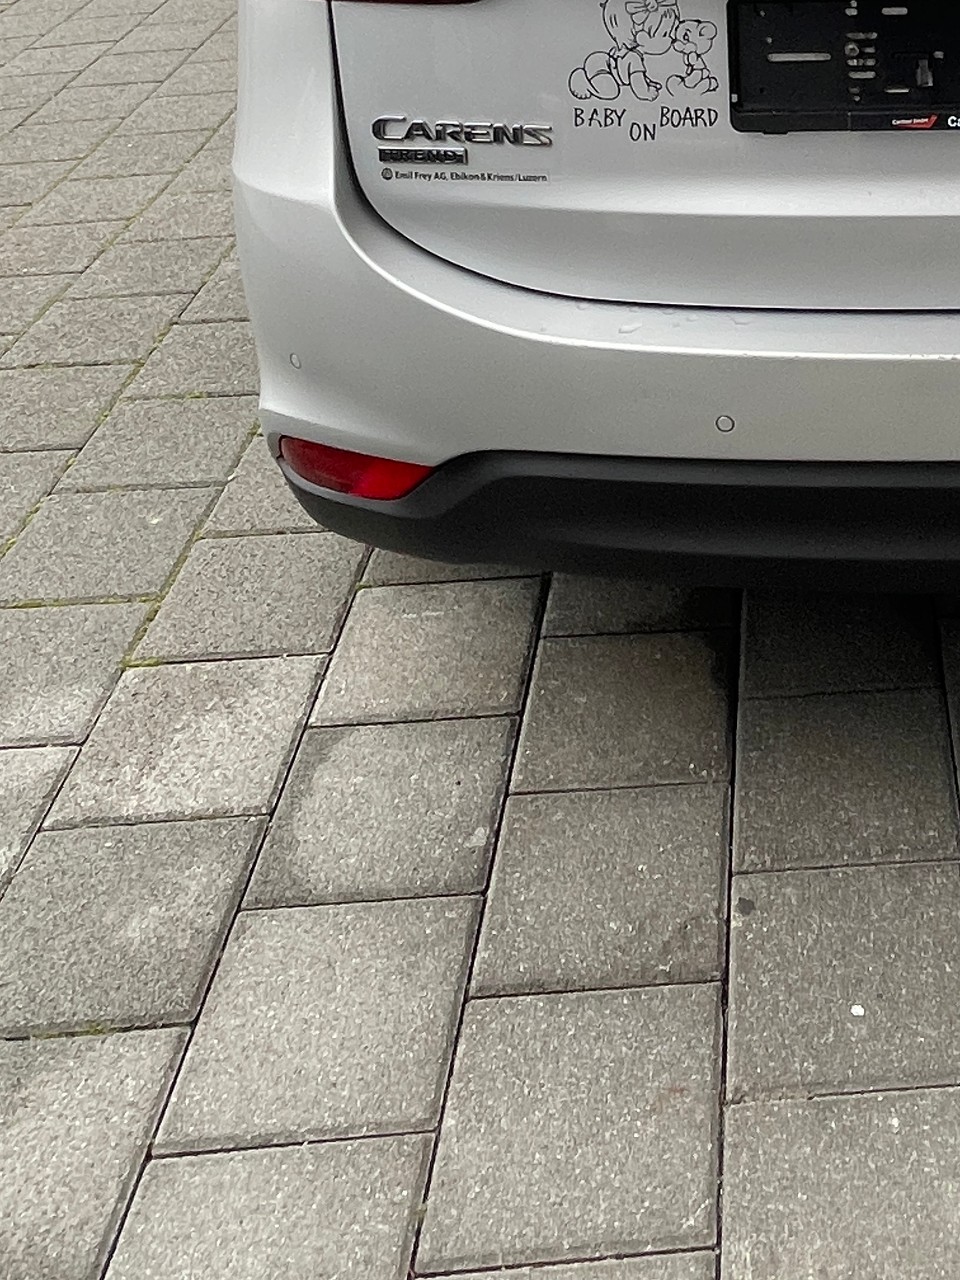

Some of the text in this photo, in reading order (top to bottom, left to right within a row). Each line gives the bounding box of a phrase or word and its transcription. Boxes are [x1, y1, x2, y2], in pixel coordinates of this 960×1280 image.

[372, 115, 553, 146] CARENS
[574, 106, 718, 141] BABY ON BOARD
[414, 171, 431, 182] Frey
